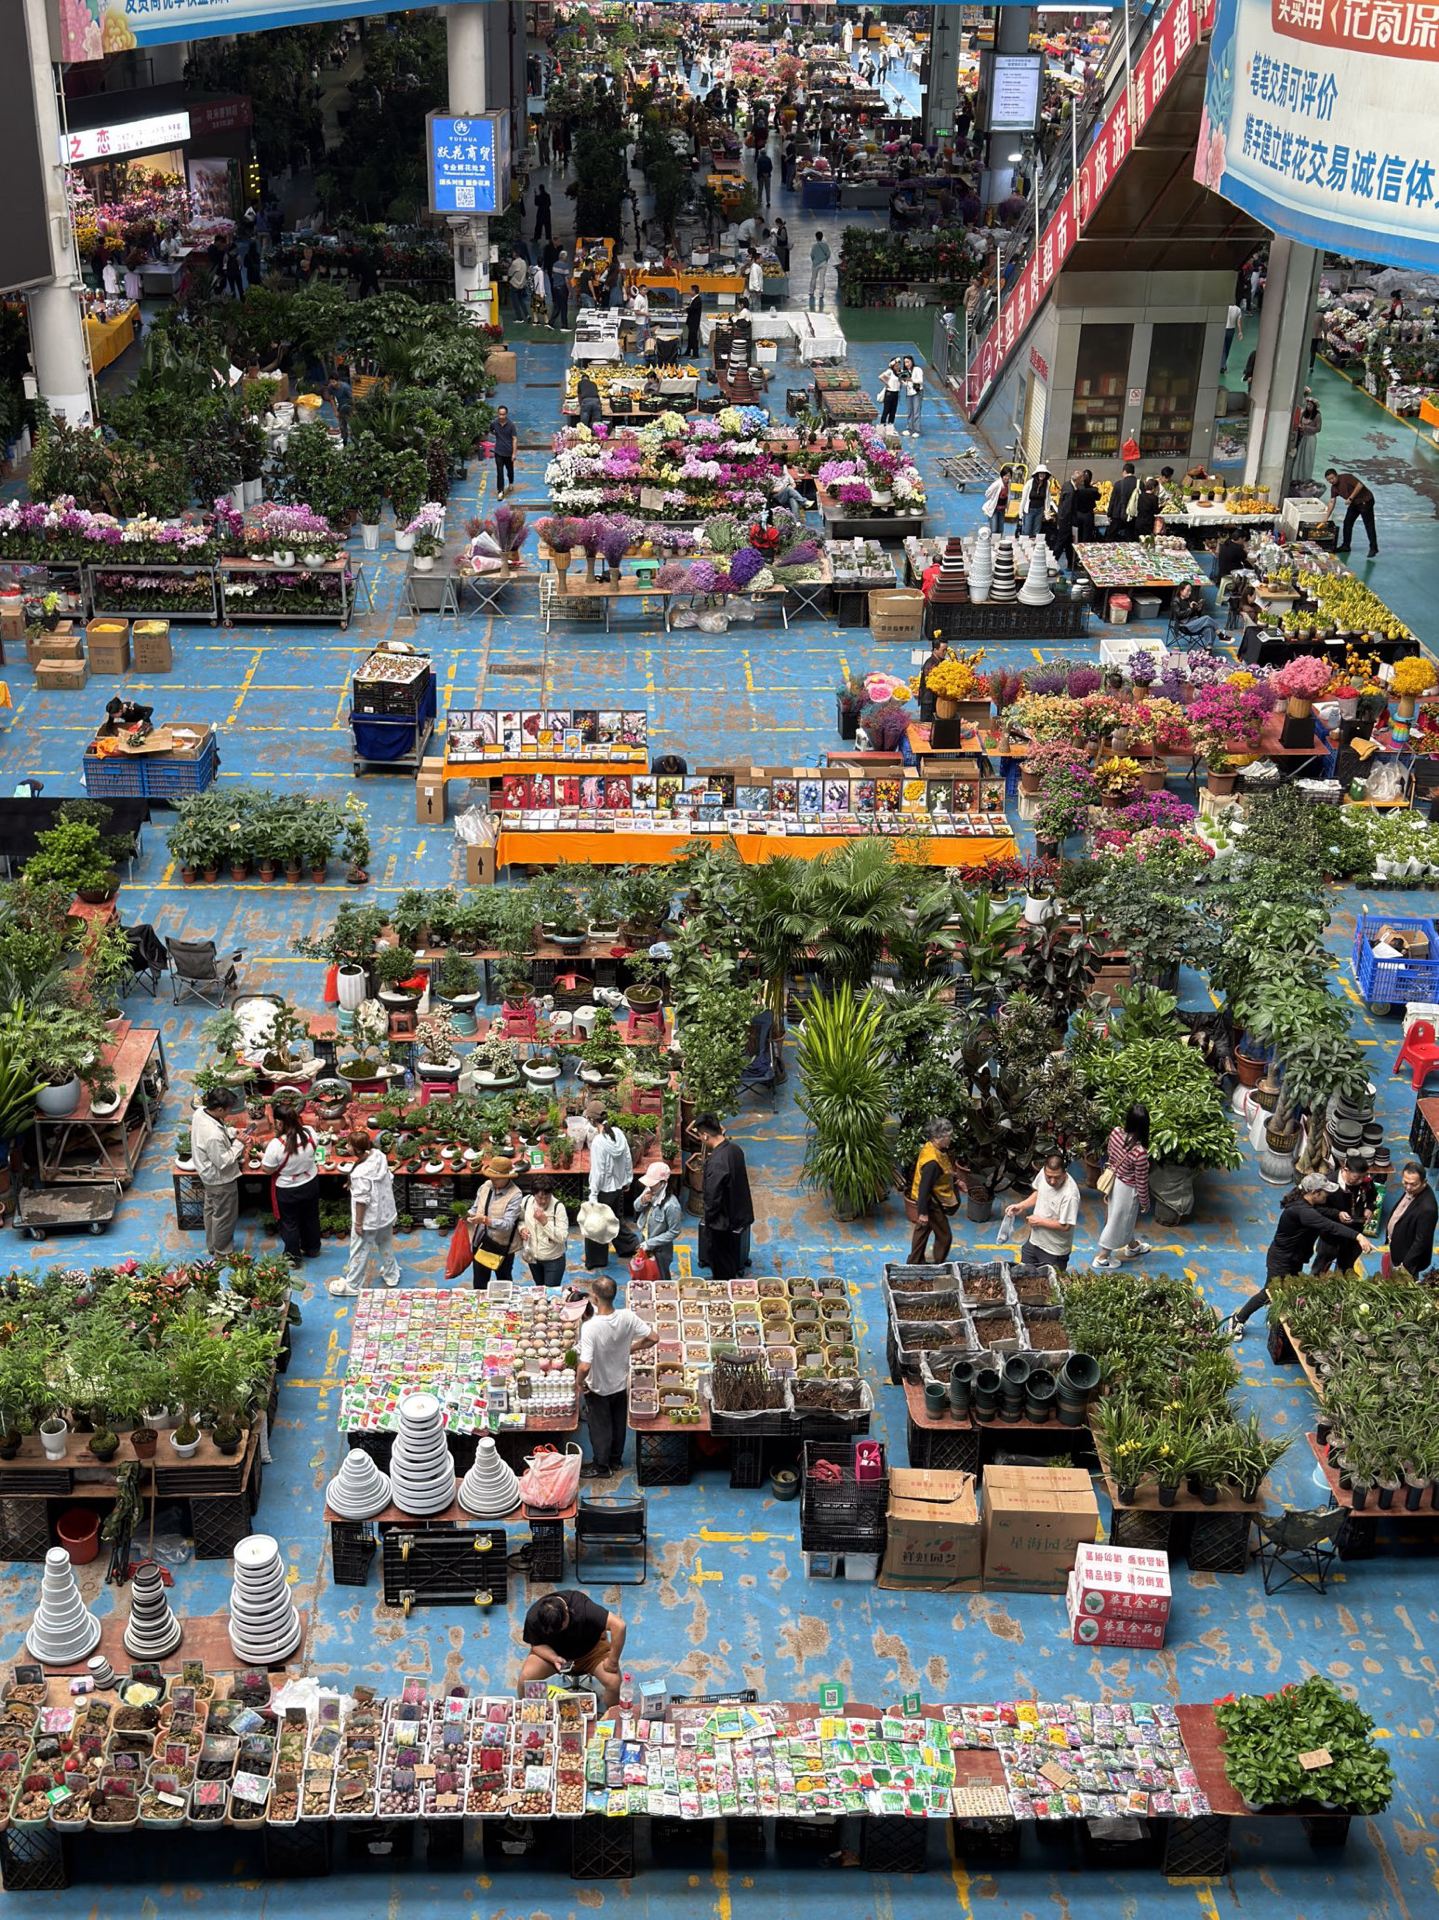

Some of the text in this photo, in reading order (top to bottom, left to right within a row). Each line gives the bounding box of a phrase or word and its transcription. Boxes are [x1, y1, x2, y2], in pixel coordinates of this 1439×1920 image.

[1250, 51, 1338, 121] 笔笔交易可评价
[70, 129, 111, 159] 之恋
[1242, 113, 1439, 209] 携手建立鲜花交易诚信体
[1127, 1573, 1165, 1588] 请勿倒置
